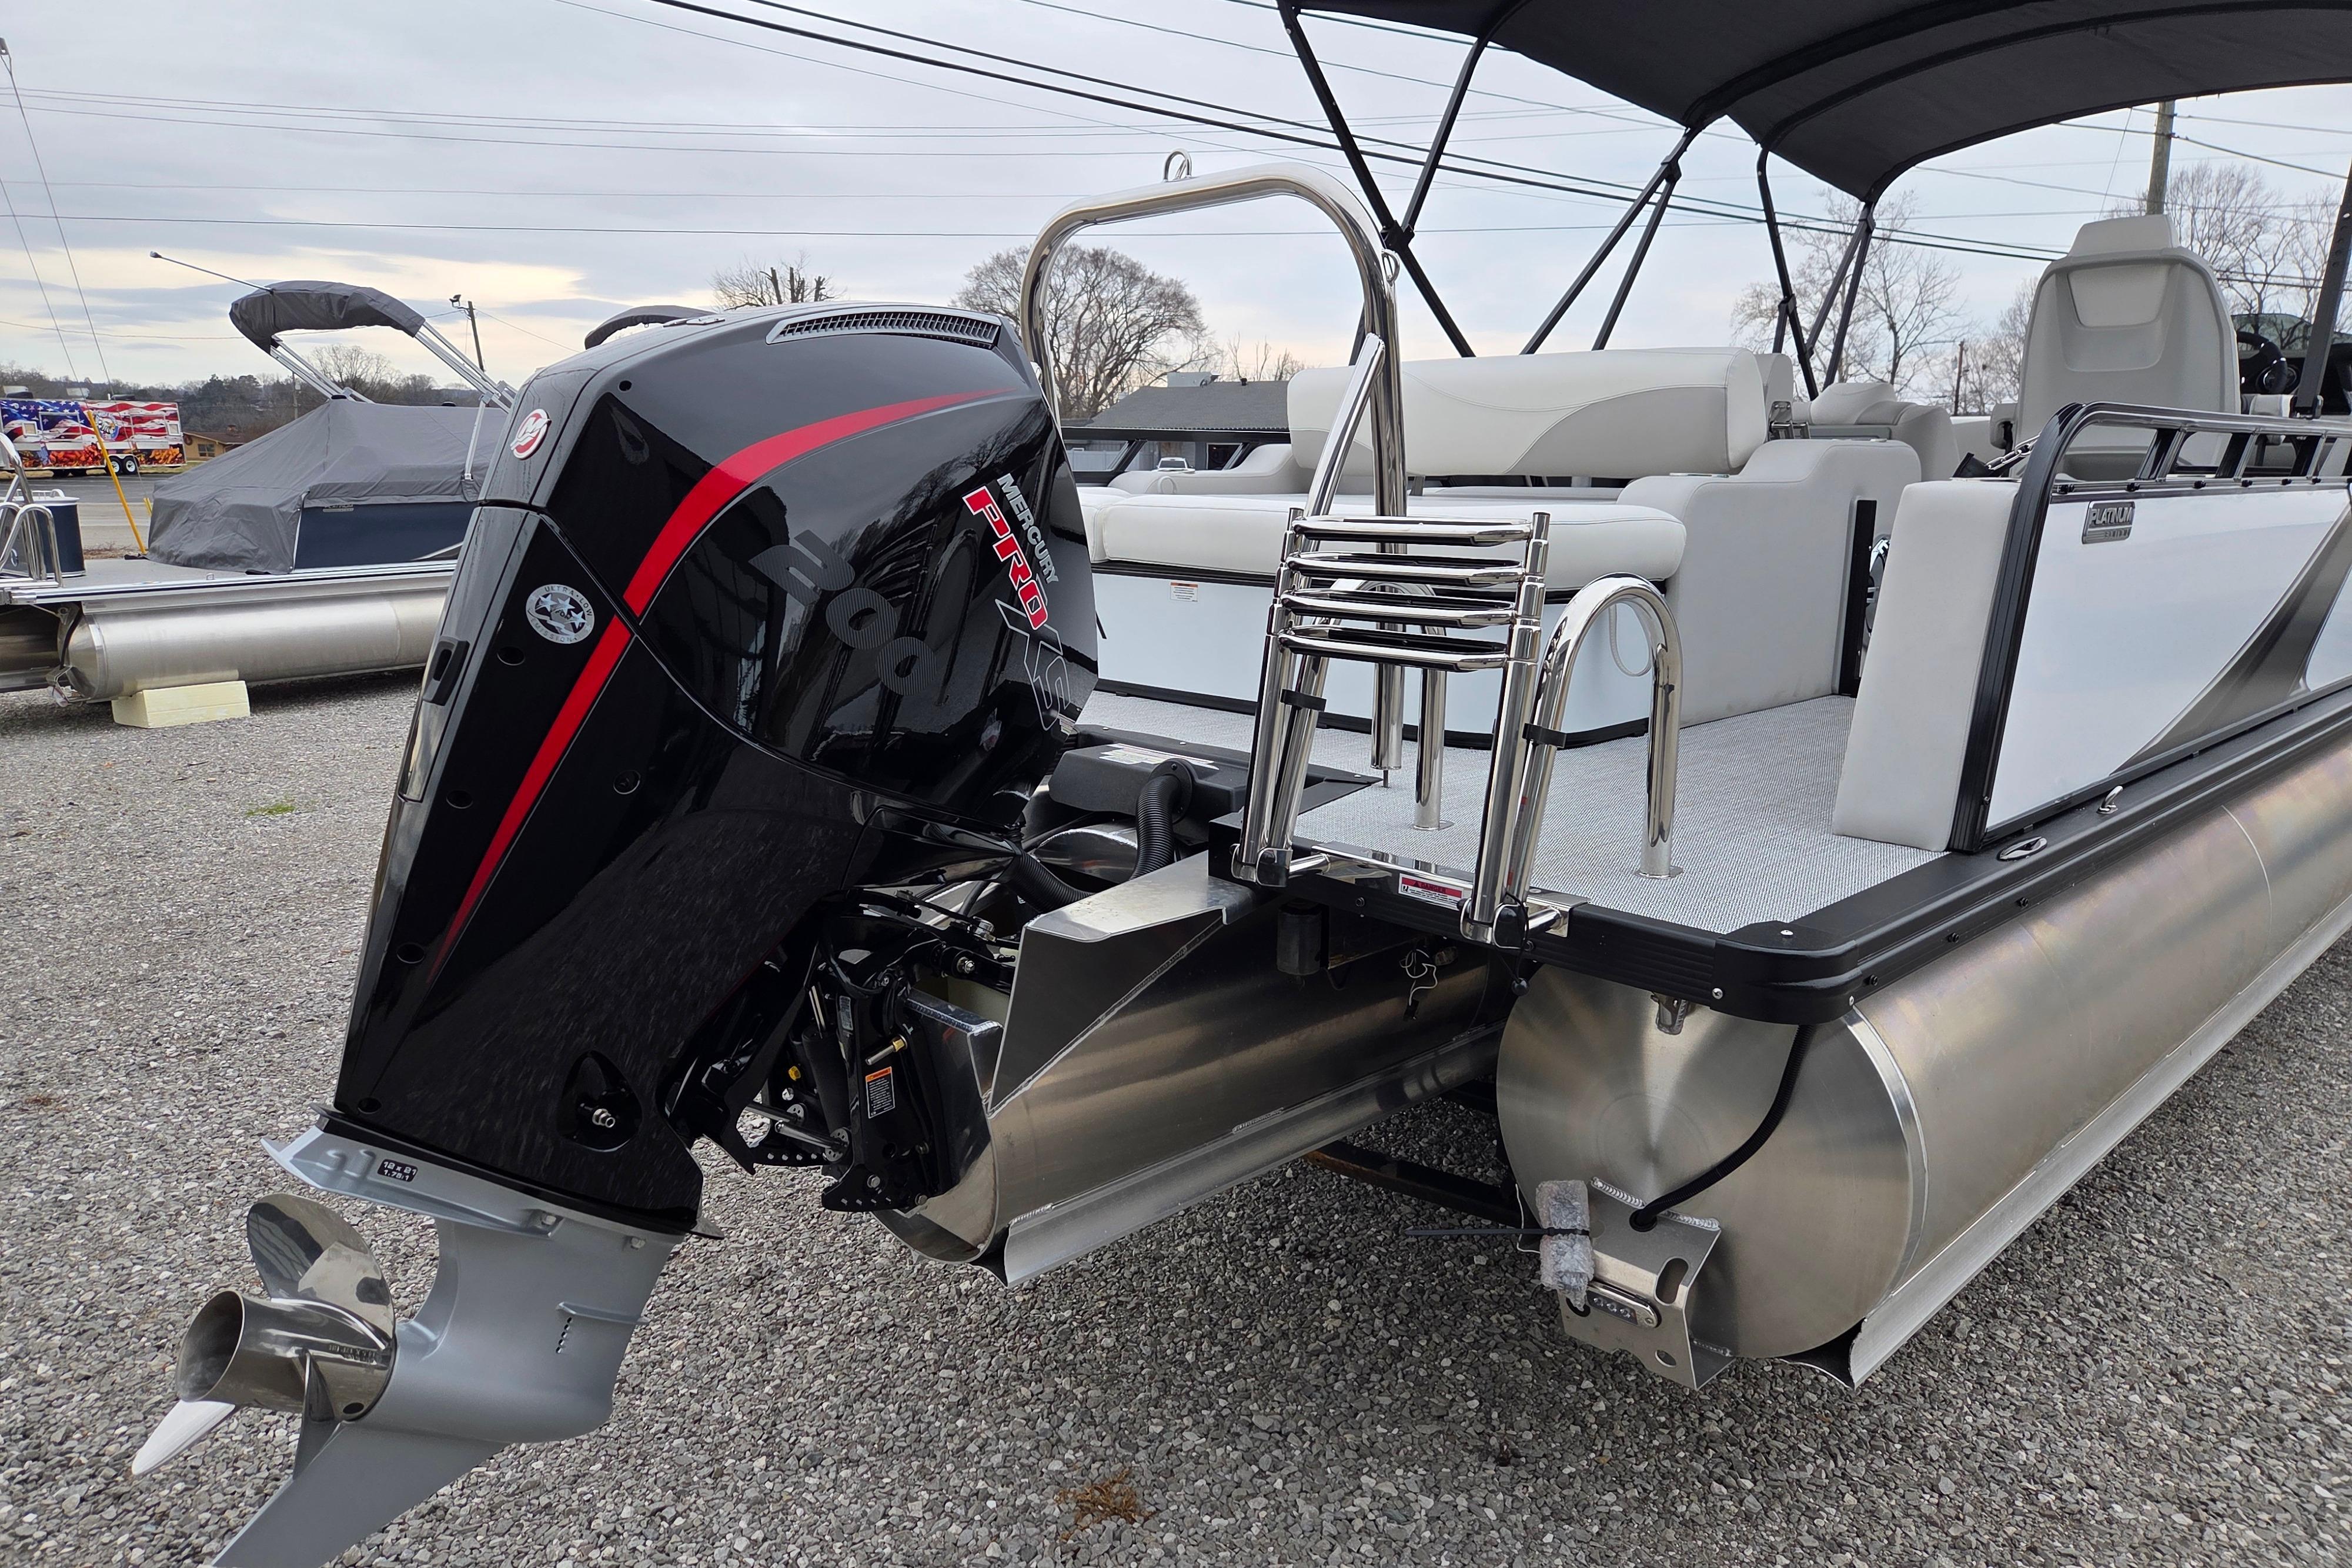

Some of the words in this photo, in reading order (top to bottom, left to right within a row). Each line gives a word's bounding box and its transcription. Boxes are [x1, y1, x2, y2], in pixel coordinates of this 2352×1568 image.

[997, 473, 1059, 584] MERCURY
[2089, 507, 2133, 525] PLATINUM
[962, 485, 1048, 630] PRO
[579, 599, 593, 616] LOW
[749, 530, 937, 696] 200
[1421, 882, 1446, 894] DANGER
